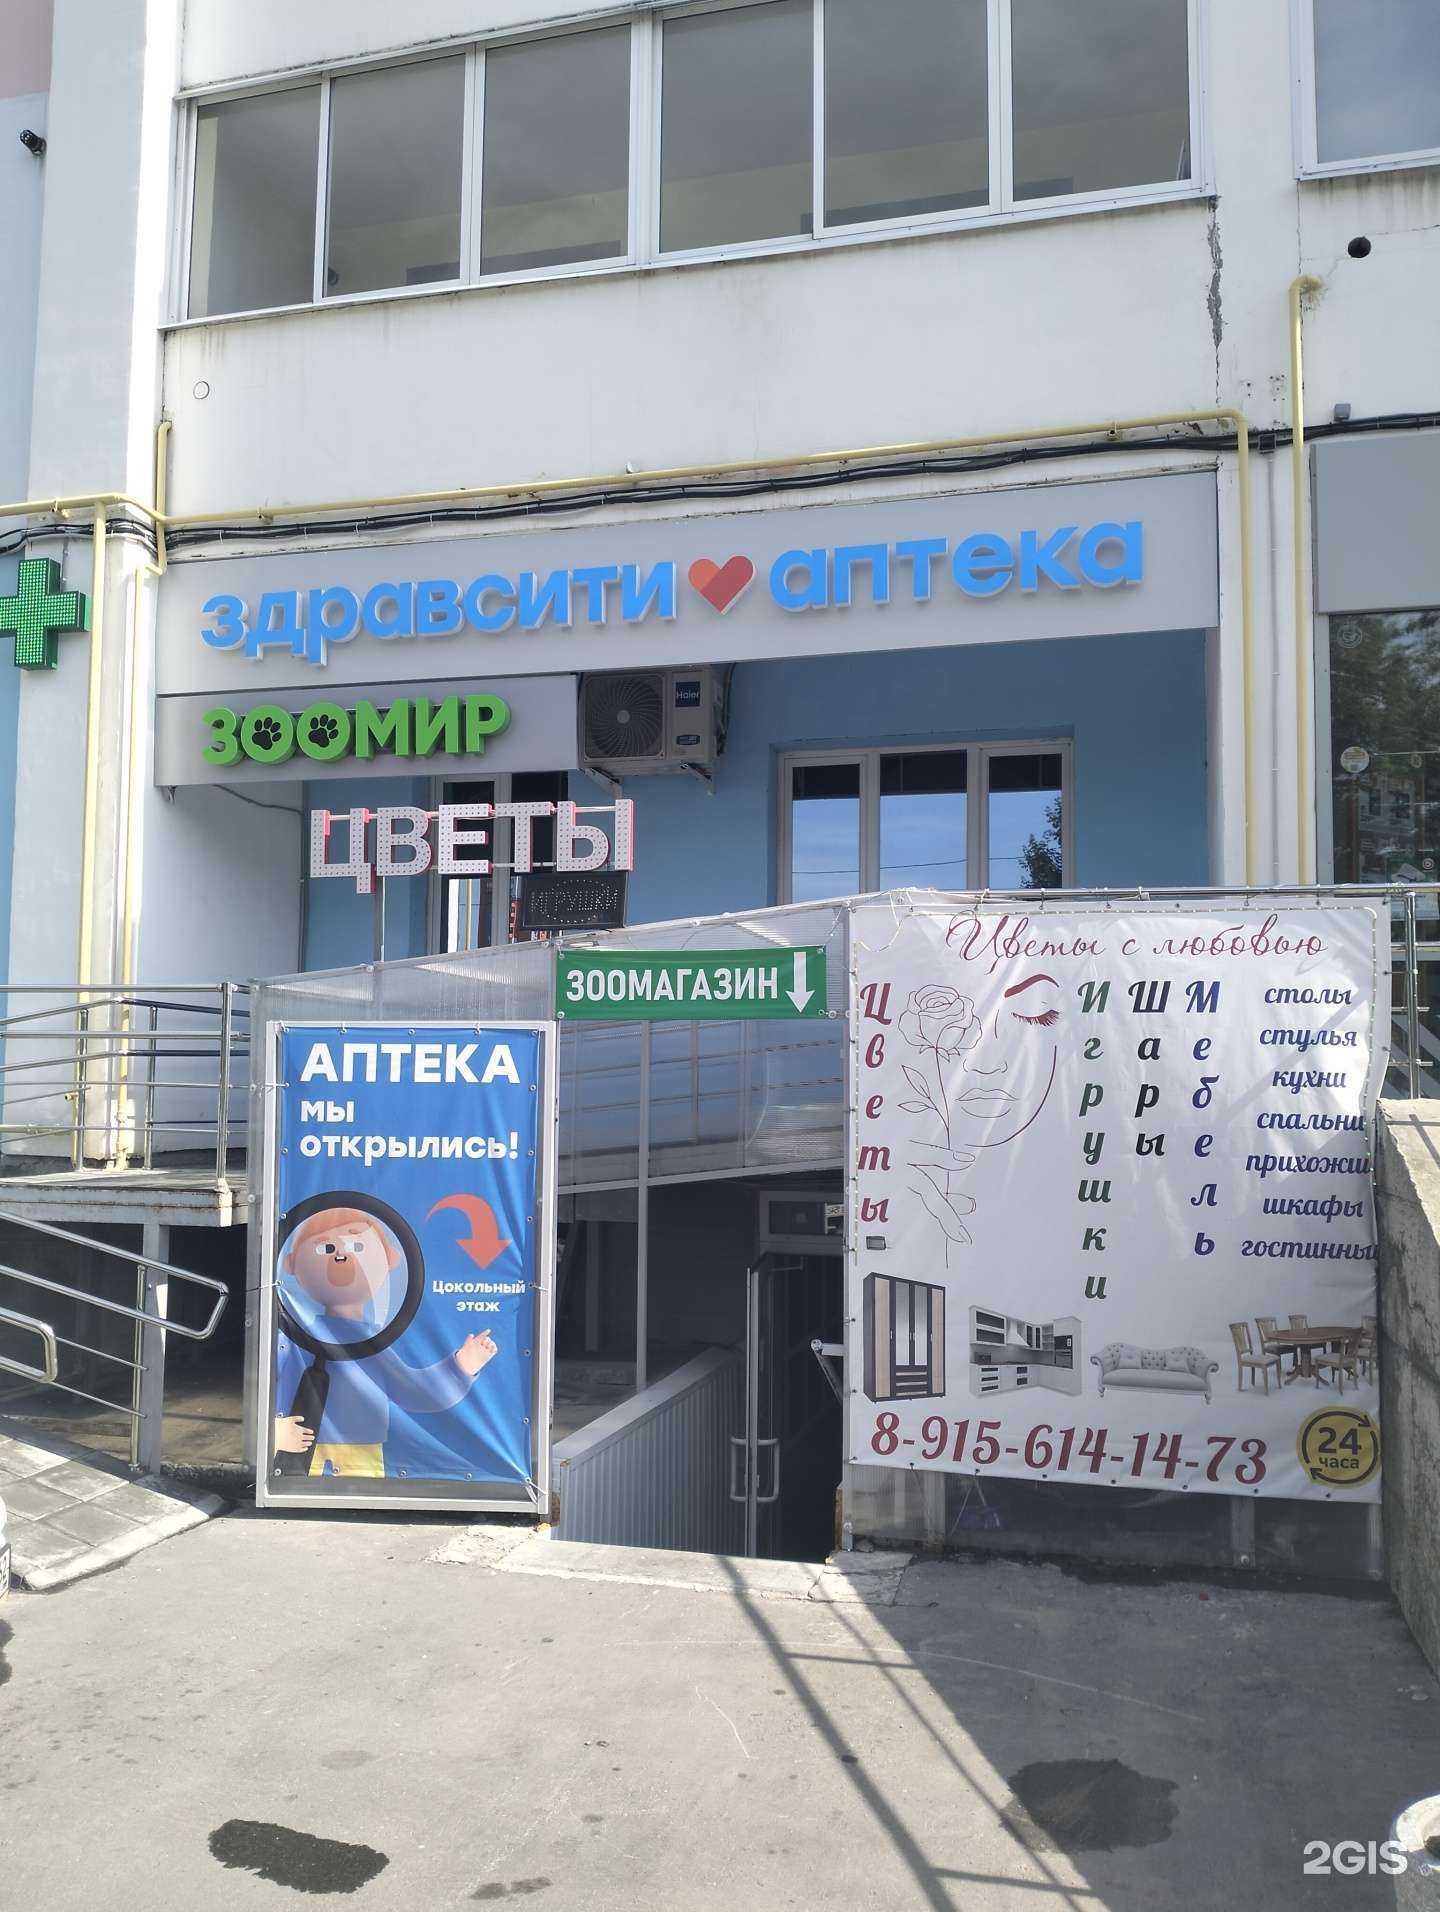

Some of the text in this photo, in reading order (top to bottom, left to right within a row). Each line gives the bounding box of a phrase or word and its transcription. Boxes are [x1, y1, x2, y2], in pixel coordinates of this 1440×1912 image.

[201, 520, 1143, 666] здравсити аптека
[202, 694, 510, 765] ЗООМИР
[310, 799, 634, 894] ЦВЕТЫ
[945, 910, 1328, 976] Цветы с любовью
[566, 967, 778, 1001] ЗООМАГАЗИН
[1264, 987, 1352, 1005] столы
[1259, 1028, 1358, 1053] стулья
[300, 1042, 521, 1084] АПТЕКА
[1272, 1070, 1347, 1095] кухни
[300, 1100, 355, 1123] мы
[1257, 1112, 1365, 1132] спальни
[300, 1131, 519, 1166] открылись!
[1263, 1195, 1364, 1223] шкафы
[432, 1278, 527, 1295] Цокольный
[456, 1298, 501, 1313] этаж
[870, 1411, 1267, 1485] 8-915-614-14-73
[1317, 1426, 1363, 1455] 24
[1318, 1455, 1361, 1471] часа
